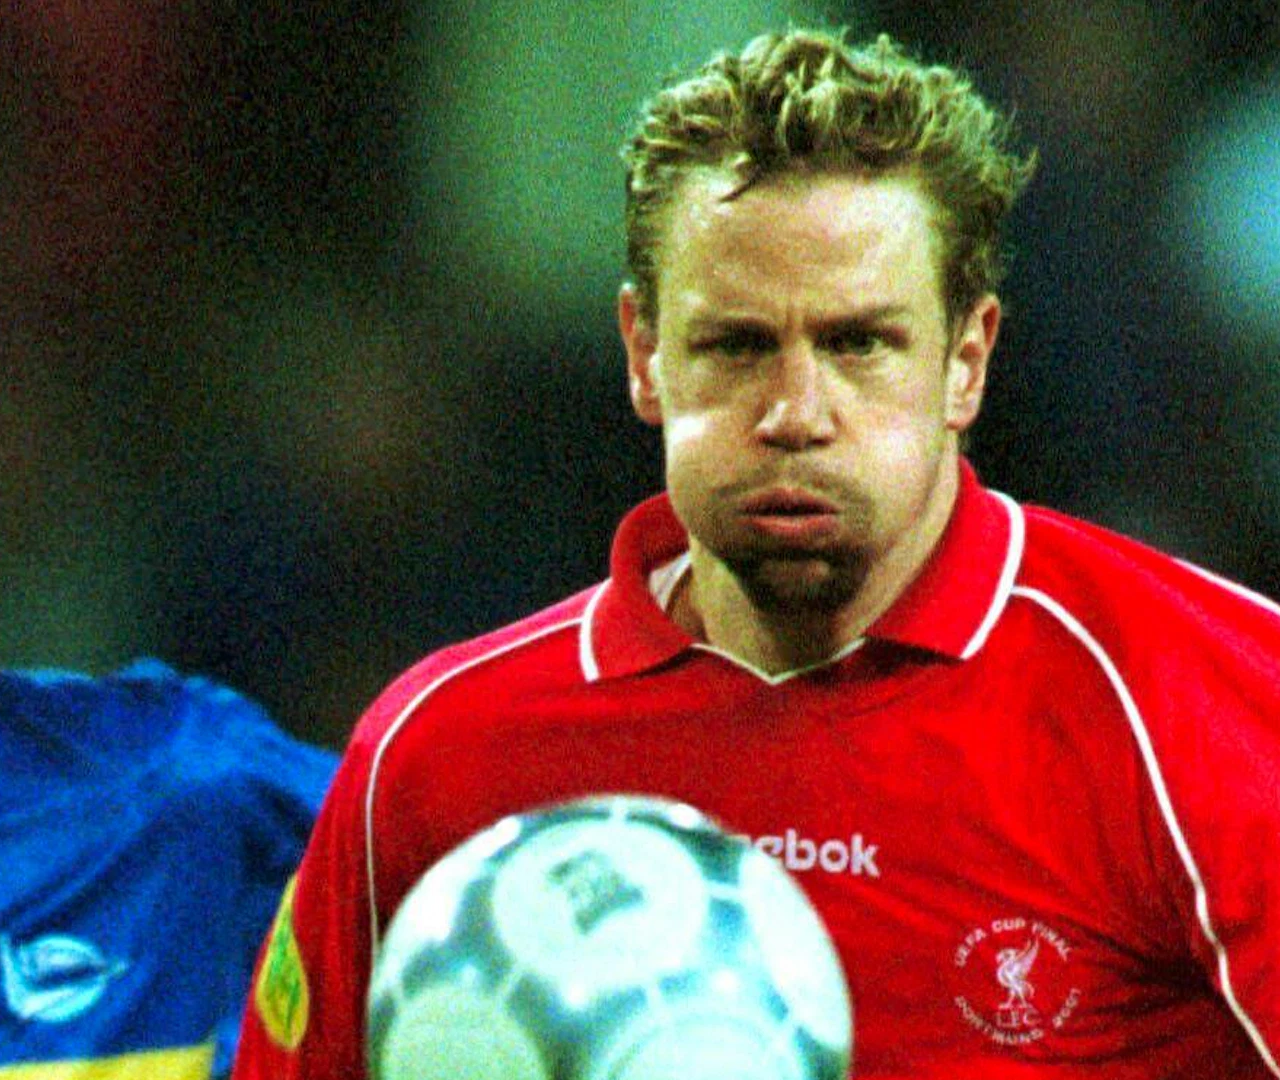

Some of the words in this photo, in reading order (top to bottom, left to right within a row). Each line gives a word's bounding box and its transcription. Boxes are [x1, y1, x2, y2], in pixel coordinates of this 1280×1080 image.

[752, 828, 881, 879] ebok
[953, 928, 988, 968] UEFA
[990, 916, 1027, 934] CUP
[1031, 921, 1073, 963] FINAL
[954, 995, 1045, 1046] DORTMUND
